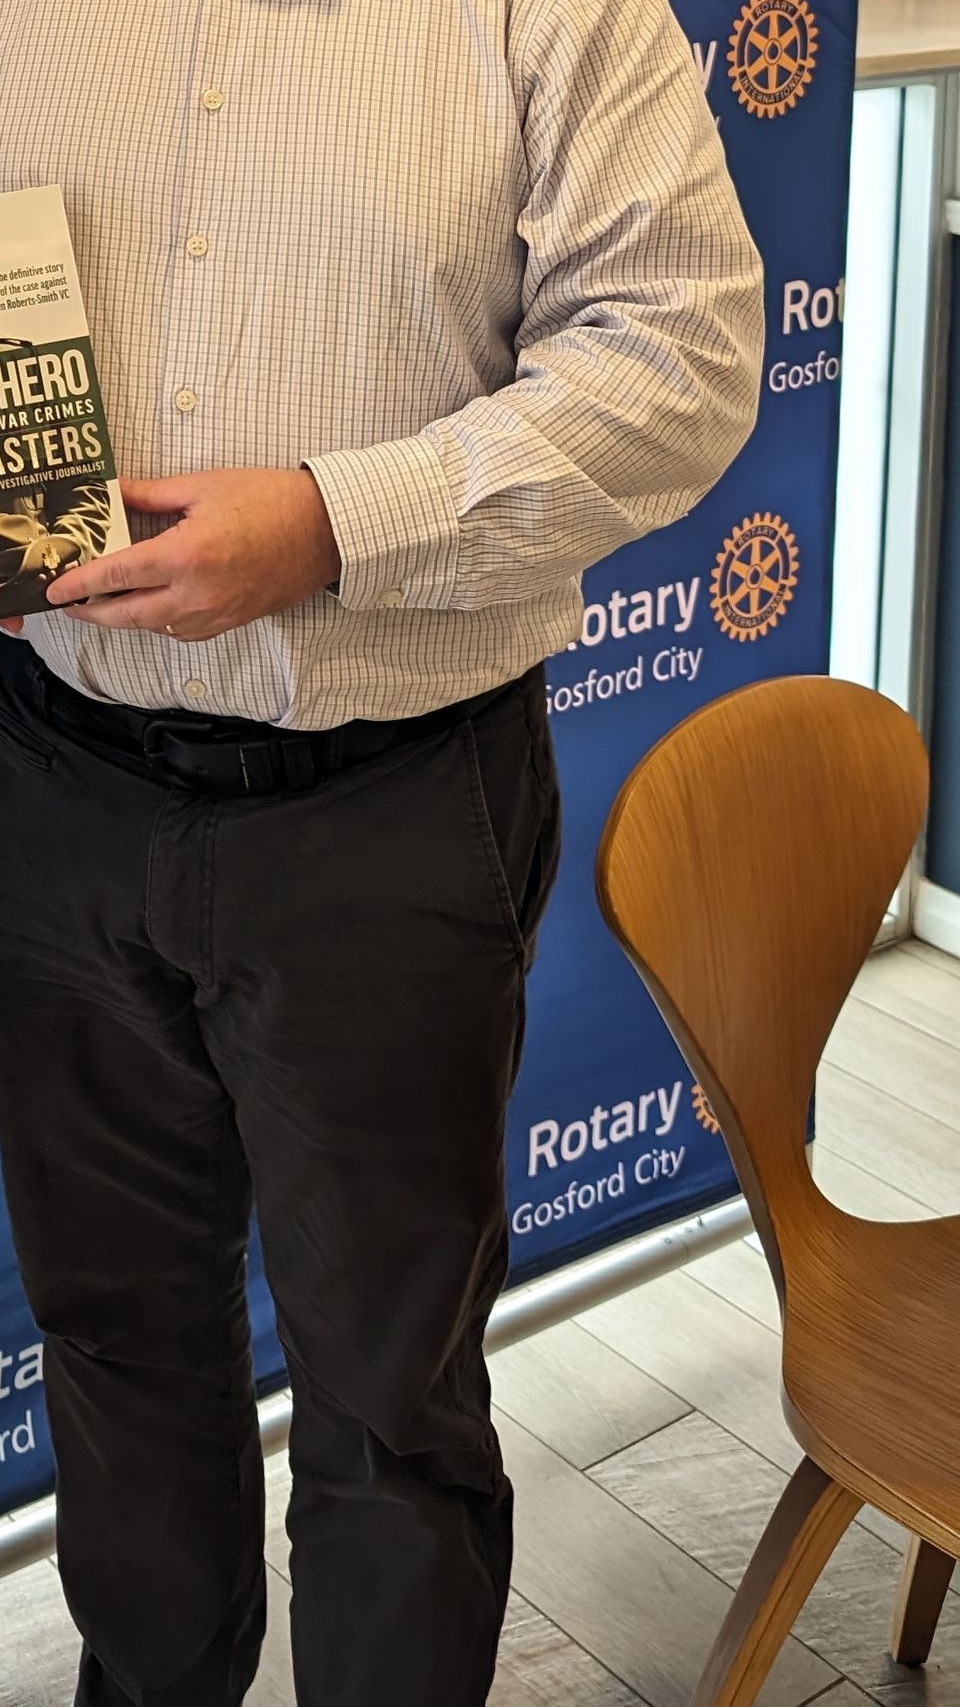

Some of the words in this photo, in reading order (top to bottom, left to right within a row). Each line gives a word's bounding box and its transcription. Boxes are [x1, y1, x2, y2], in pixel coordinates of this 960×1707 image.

[0, 285, 8, 296] of
[9, 284, 21, 295] the
[22, 282, 39, 292] case
[40, 276, 67, 290] against
[9, 266, 44, 281] definitive
[44, 263, 64, 274] story
[6, 290, 59, 310] Roberts-Smith
[58, 289, 70, 300] VC
[782, 278, 846, 335] Rot
[768, 350, 839, 393] Gosfo
[34, 399, 95, 423] CRIMES
[55, 460, 106, 481] JOURNALIST
[567, 576, 700, 651] otary
[652, 646, 703, 682] City
[528, 1081, 682, 1177] Rotary
[512, 1162, 625, 1234] Gosford
[634, 1146, 685, 1184] City
